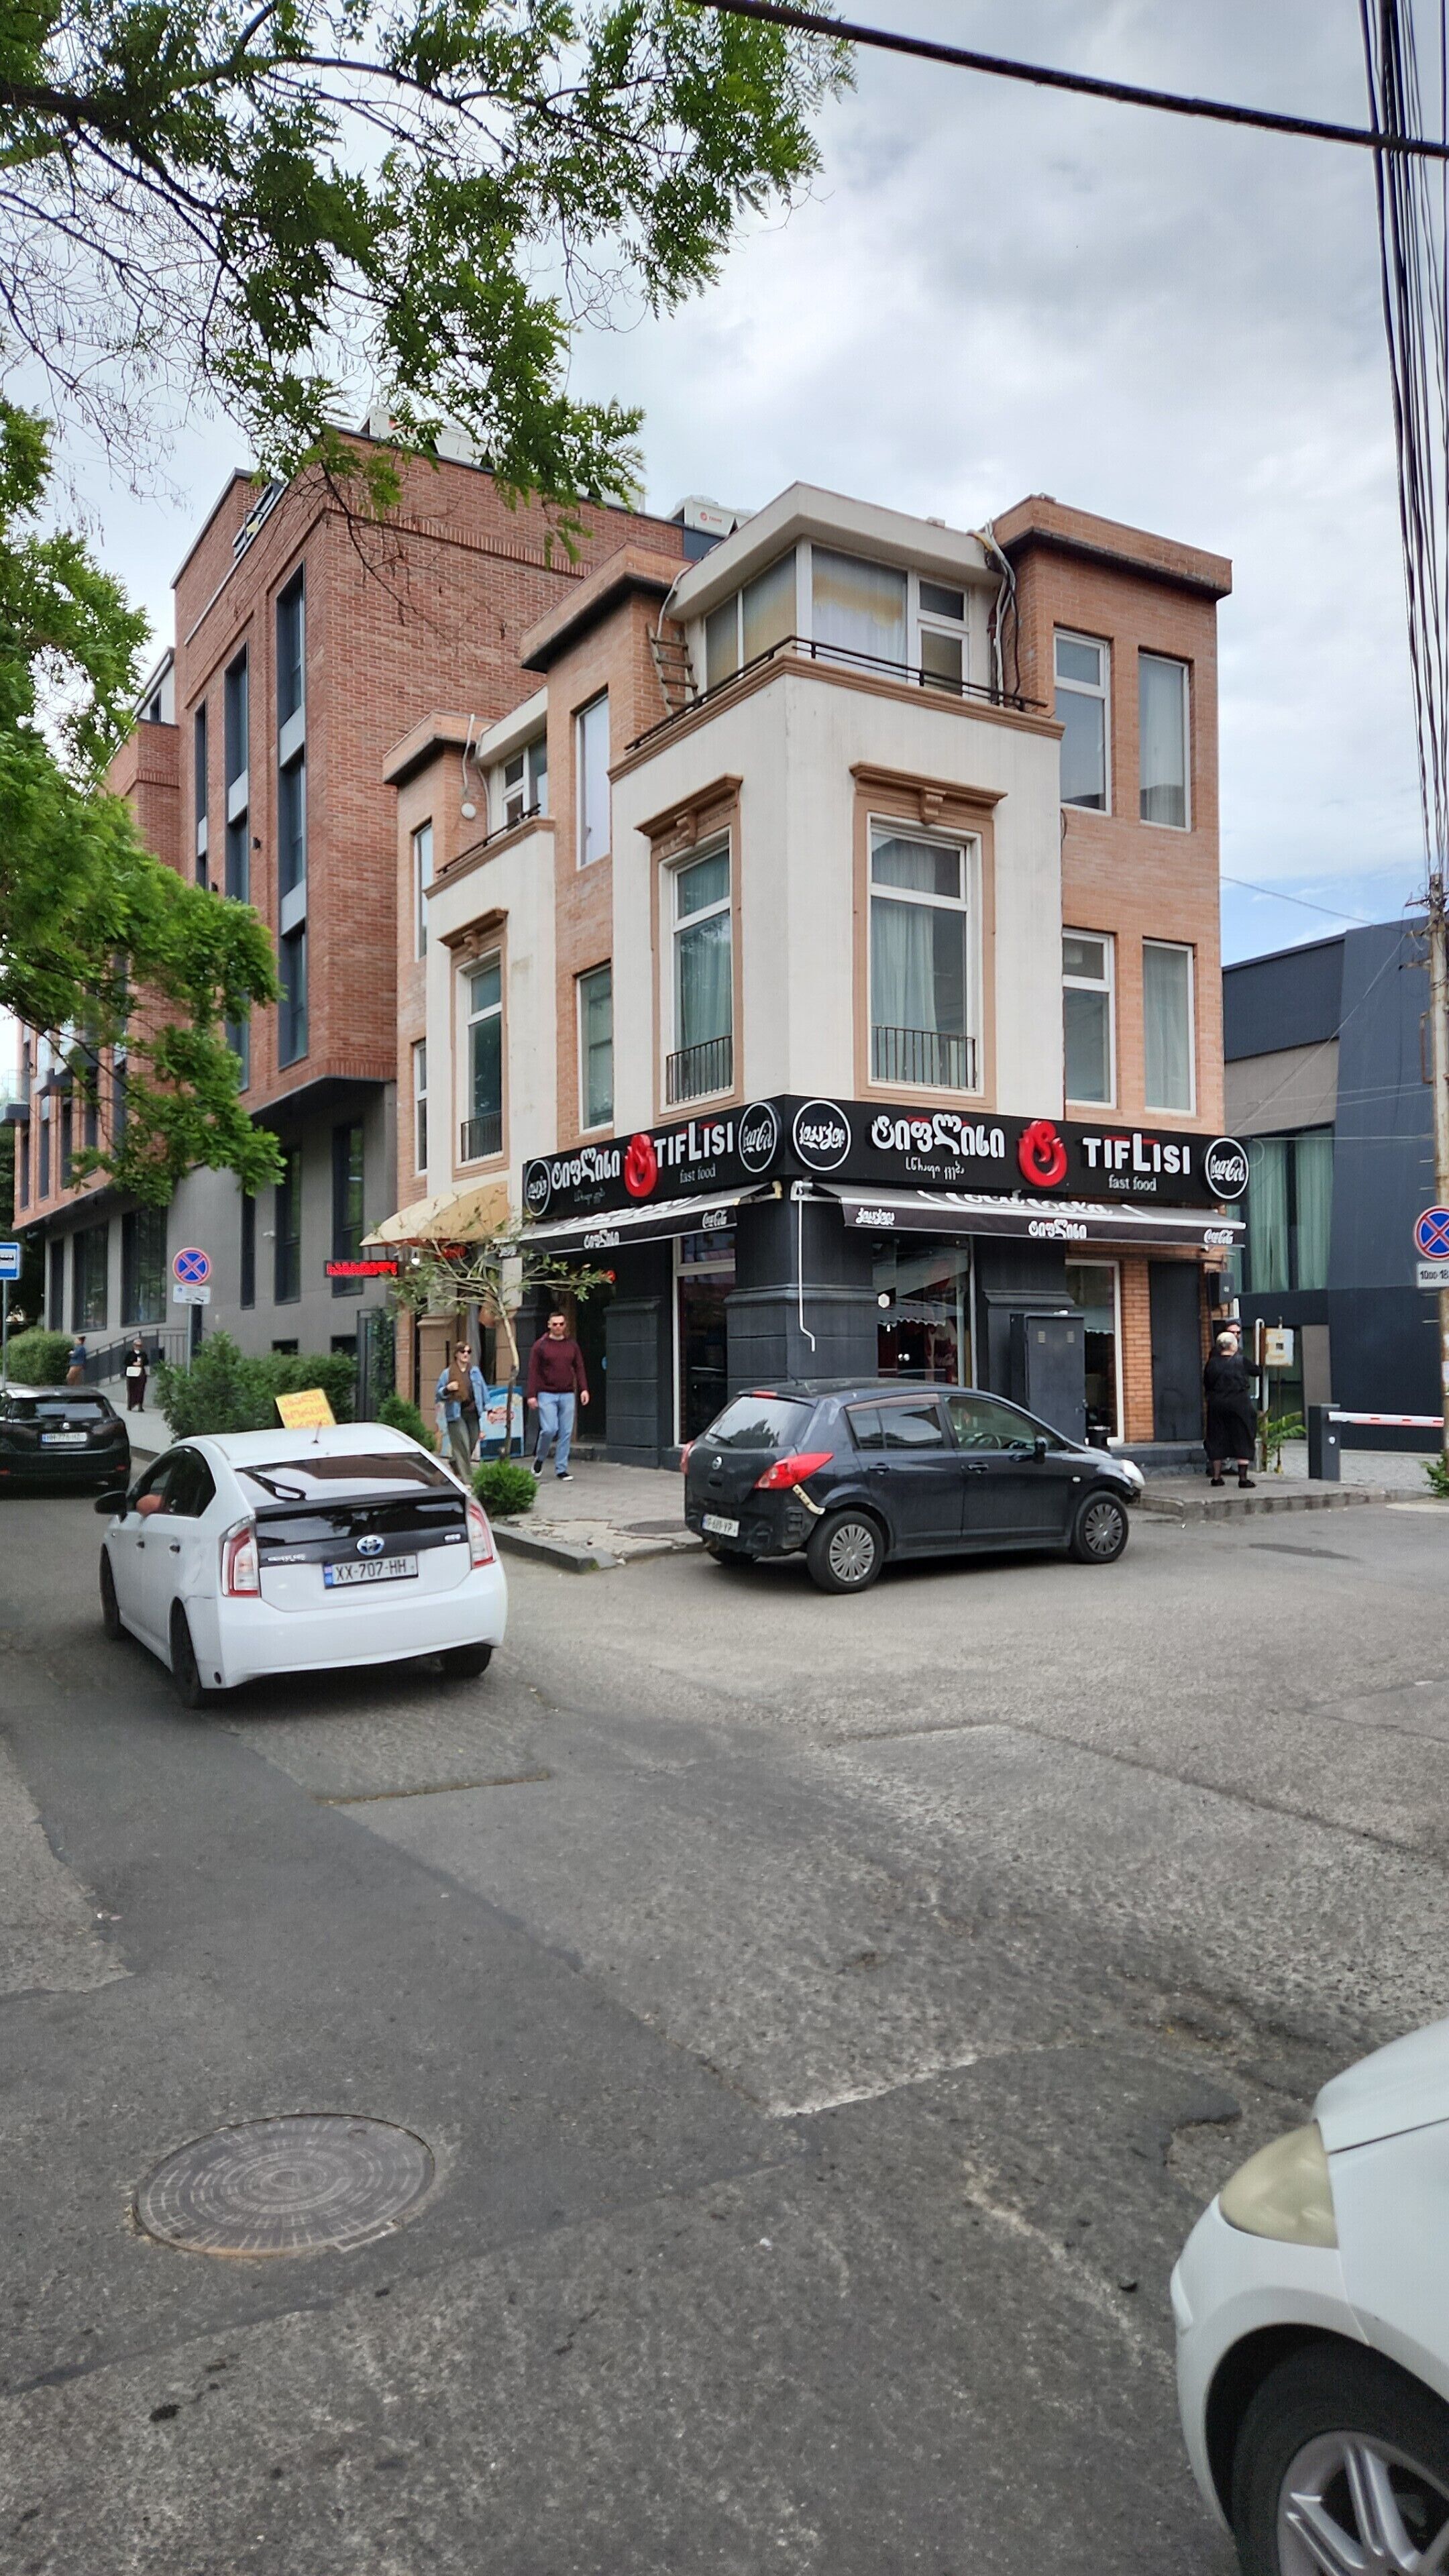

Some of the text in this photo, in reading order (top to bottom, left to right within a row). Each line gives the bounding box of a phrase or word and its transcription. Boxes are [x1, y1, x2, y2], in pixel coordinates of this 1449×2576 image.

[654, 1120, 734, 1169] TIFLISI
[871, 1113, 1005, 1159] ტიფლისი
[551, 1146, 621, 1190] ტიფლისი
[1082, 1132, 1191, 1175] TIFLISI
[680, 1163, 716, 1184] fast food
[1108, 1174, 1157, 1191] fast food
[1028, 1218, 1087, 1240] ტიფლისი
[335, 1558, 407, 1580] XX-707-HH
